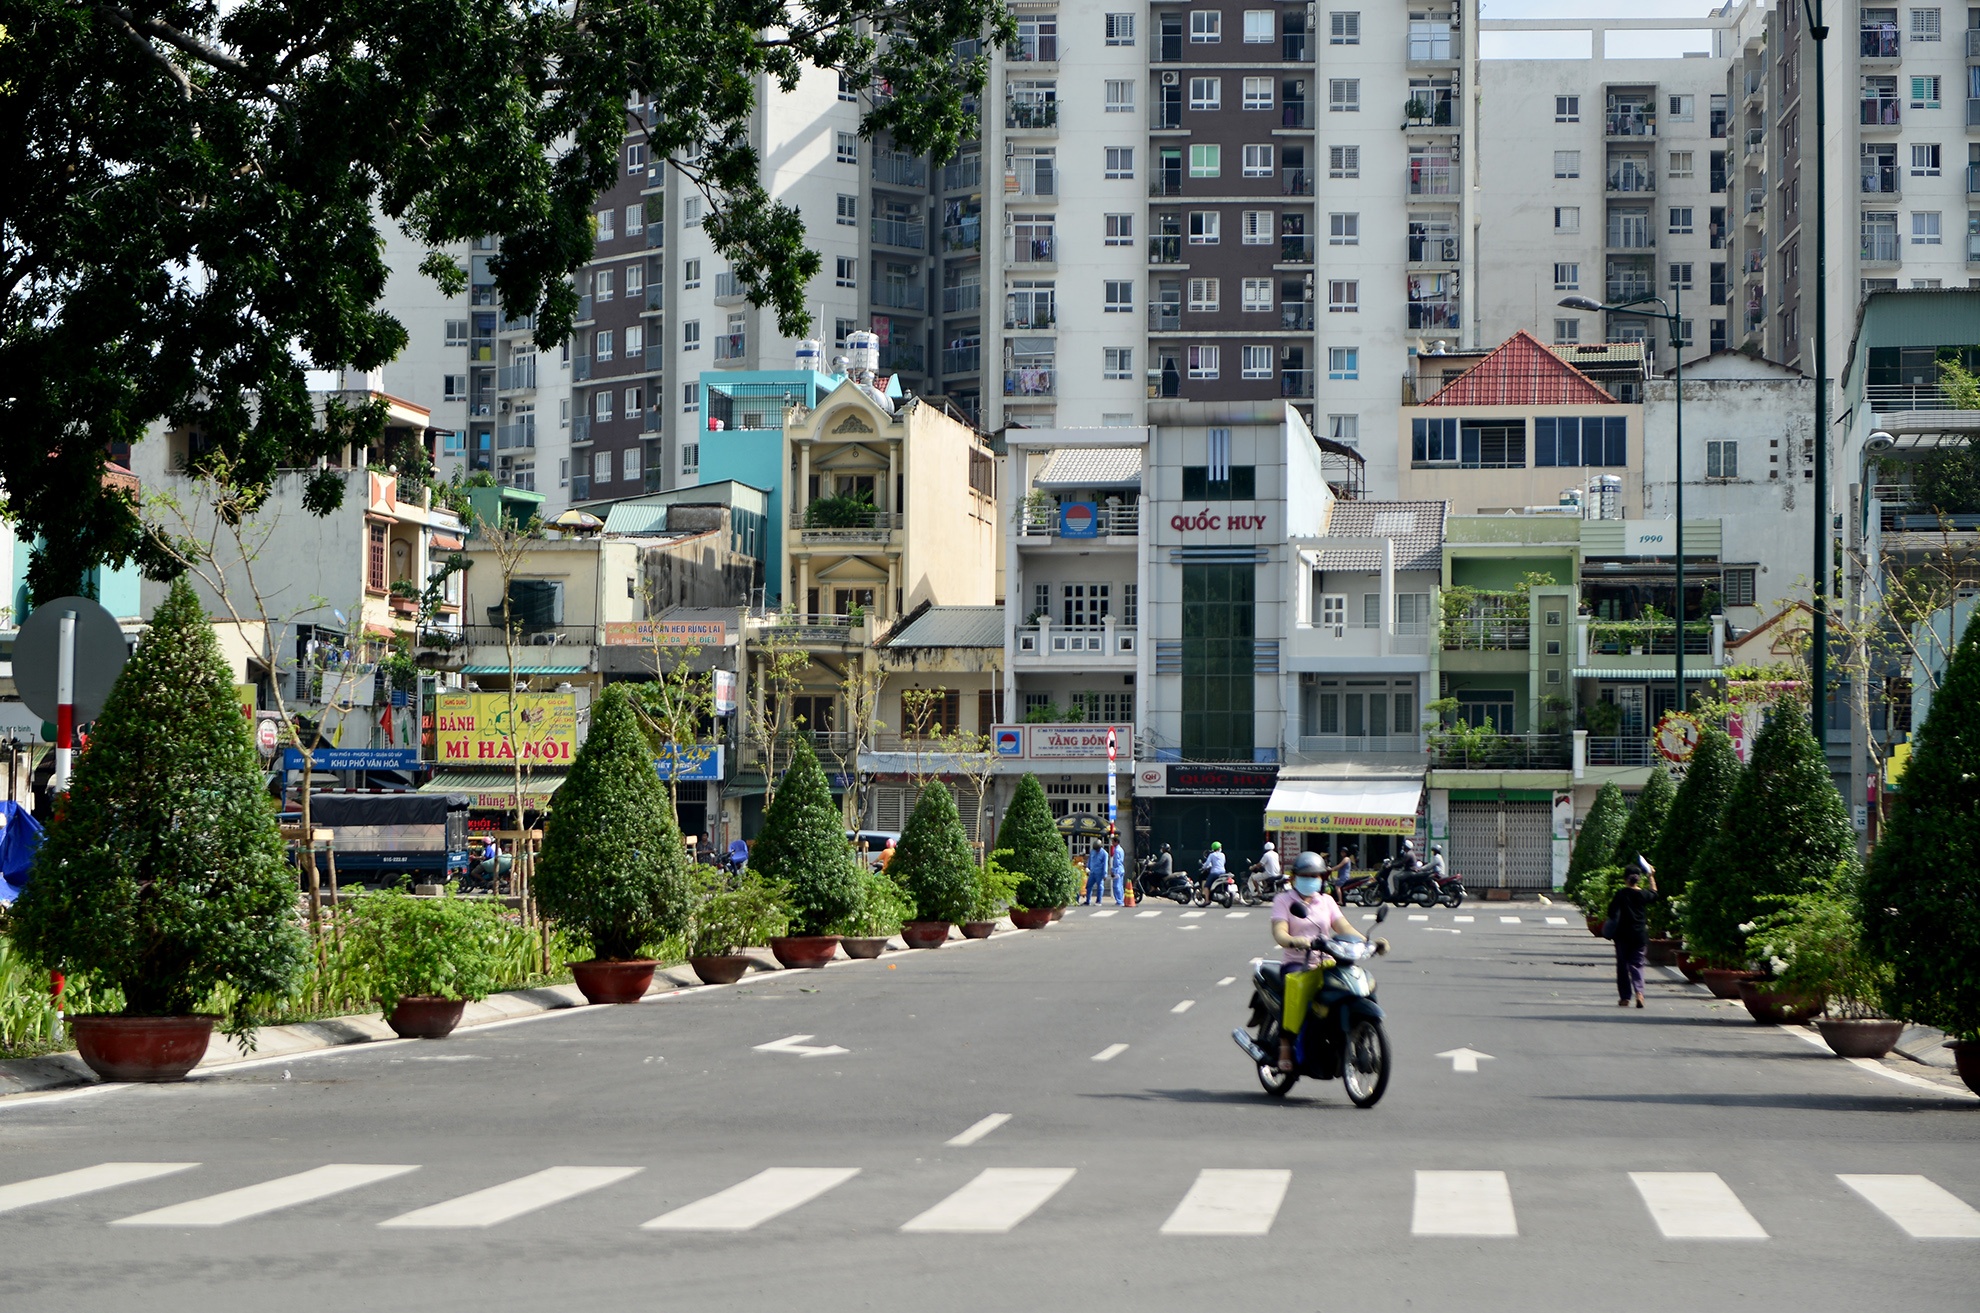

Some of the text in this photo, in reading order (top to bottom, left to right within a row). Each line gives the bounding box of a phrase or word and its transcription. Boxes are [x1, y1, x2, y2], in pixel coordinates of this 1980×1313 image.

[1170, 508, 1266, 532] QUỐC HUY
[1639, 535, 1664, 543] 1990
[671, 625, 686, 633] HEO
[709, 625, 720, 633] LAI
[440, 712, 475, 731] BÁNH
[446, 736, 569, 762] MÌ HÀ NỘI
[349, 757, 365, 767] PHỐ
[367, 758, 382, 767] VĂN
[383, 758, 399, 767] HÓA
[1180, 772, 1270, 784] QUỐC HUY
[478, 794, 505, 808] Hùng
[508, 794, 534, 808] Dng
[1284, 815, 1296, 824] ĐẠI
[1298, 815, 1307, 823] LÝ
[1309, 816, 1318, 824] VÉ
[1320, 815, 1330, 824] SỐ
[1333, 816, 1363, 826] THỊNH
